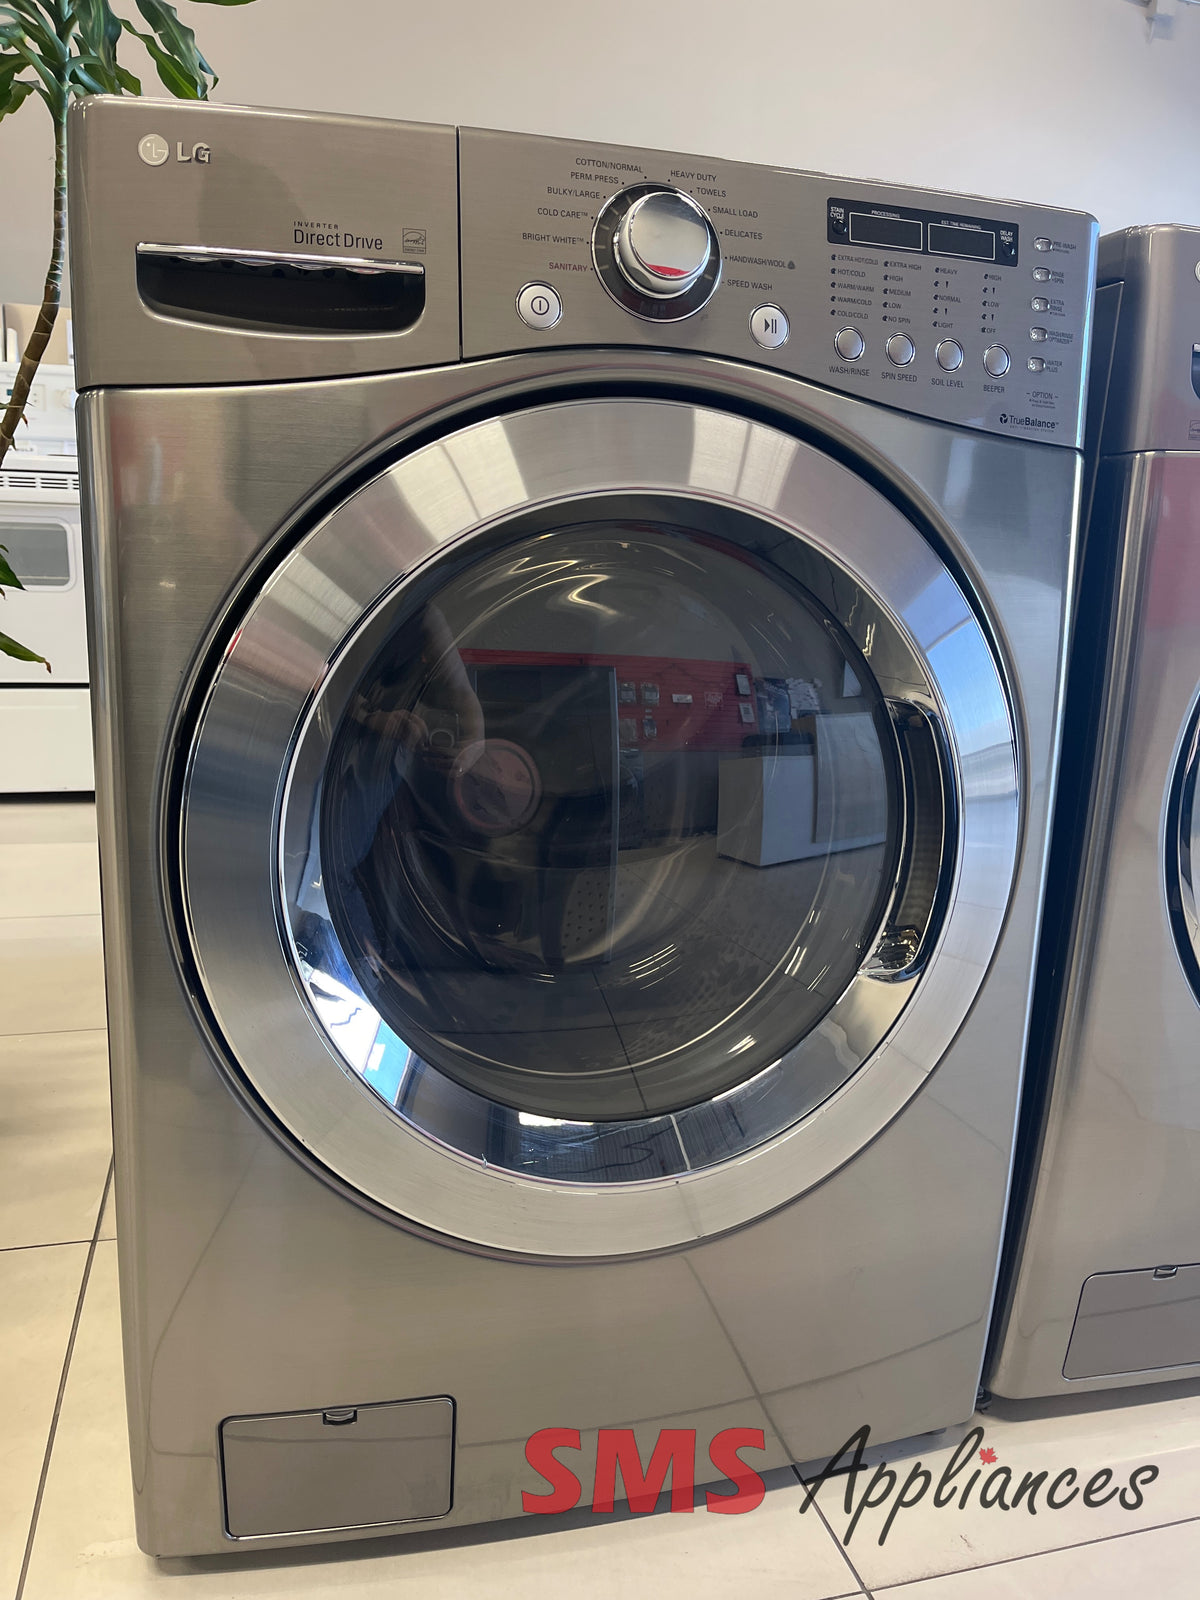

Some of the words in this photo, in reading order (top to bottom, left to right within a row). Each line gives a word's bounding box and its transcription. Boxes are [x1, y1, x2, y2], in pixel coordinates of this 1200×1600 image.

[177, 142, 210, 163] LG
[575, 158, 643, 173] COTTON/NORMAL
[670, 170, 696, 180] HEAVY
[696, 173, 717, 182] DUTY
[547, 187, 600, 199] BULKY/LARGE
[697, 187, 727, 198] TOWELS
[537, 208, 559, 217] COLD
[712, 206, 737, 216] SMALL
[738, 208, 758, 219] LOAD
[871, 210, 900, 219] PROCESSING
[293, 221, 339, 230] INVERTER
[522, 233, 551, 242] BRIGHT
[724, 228, 763, 240] DELICATES
[294, 229, 340, 247] Direct
[344, 233, 383, 250] Drive
[729, 255, 786, 269] HANDWASH/WOOL
[837, 254, 854, 262] EXTRA
[548, 262, 588, 272] SANITARY
[889, 261, 907, 270] EXTRA
[907, 262, 922, 271] HIGH
[940, 266, 958, 275] HEAVY
[837, 268, 866, 278] HOT/COLD
[889, 275, 903, 283] HIGH
[727, 280, 750, 288] SPEED
[751, 281, 773, 291] WASH
[837, 283, 875, 293] WARM/WARM
[888, 287, 912, 298] MEDIUM
[837, 296, 872, 306] WARM/COLD
[939, 293, 961, 303] NORMAL
[888, 301, 902, 309] LOW
[987, 300, 999, 308] LOW
[837, 310, 869, 320] COLD/COLD
[887, 315, 897, 323] NO
[898, 316, 911, 325] SPIN
[986, 327, 996, 335] OFF
[829, 366, 871, 378] WASH/RINSE
[881, 371, 898, 381] SPIN
[898, 373, 918, 384] SPEED
[931, 377, 946, 388] SOIL
[946, 379, 965, 389] LEVEL
[983, 384, 1006, 394] BEEPER
[1032, 391, 1053, 400] OPTION
